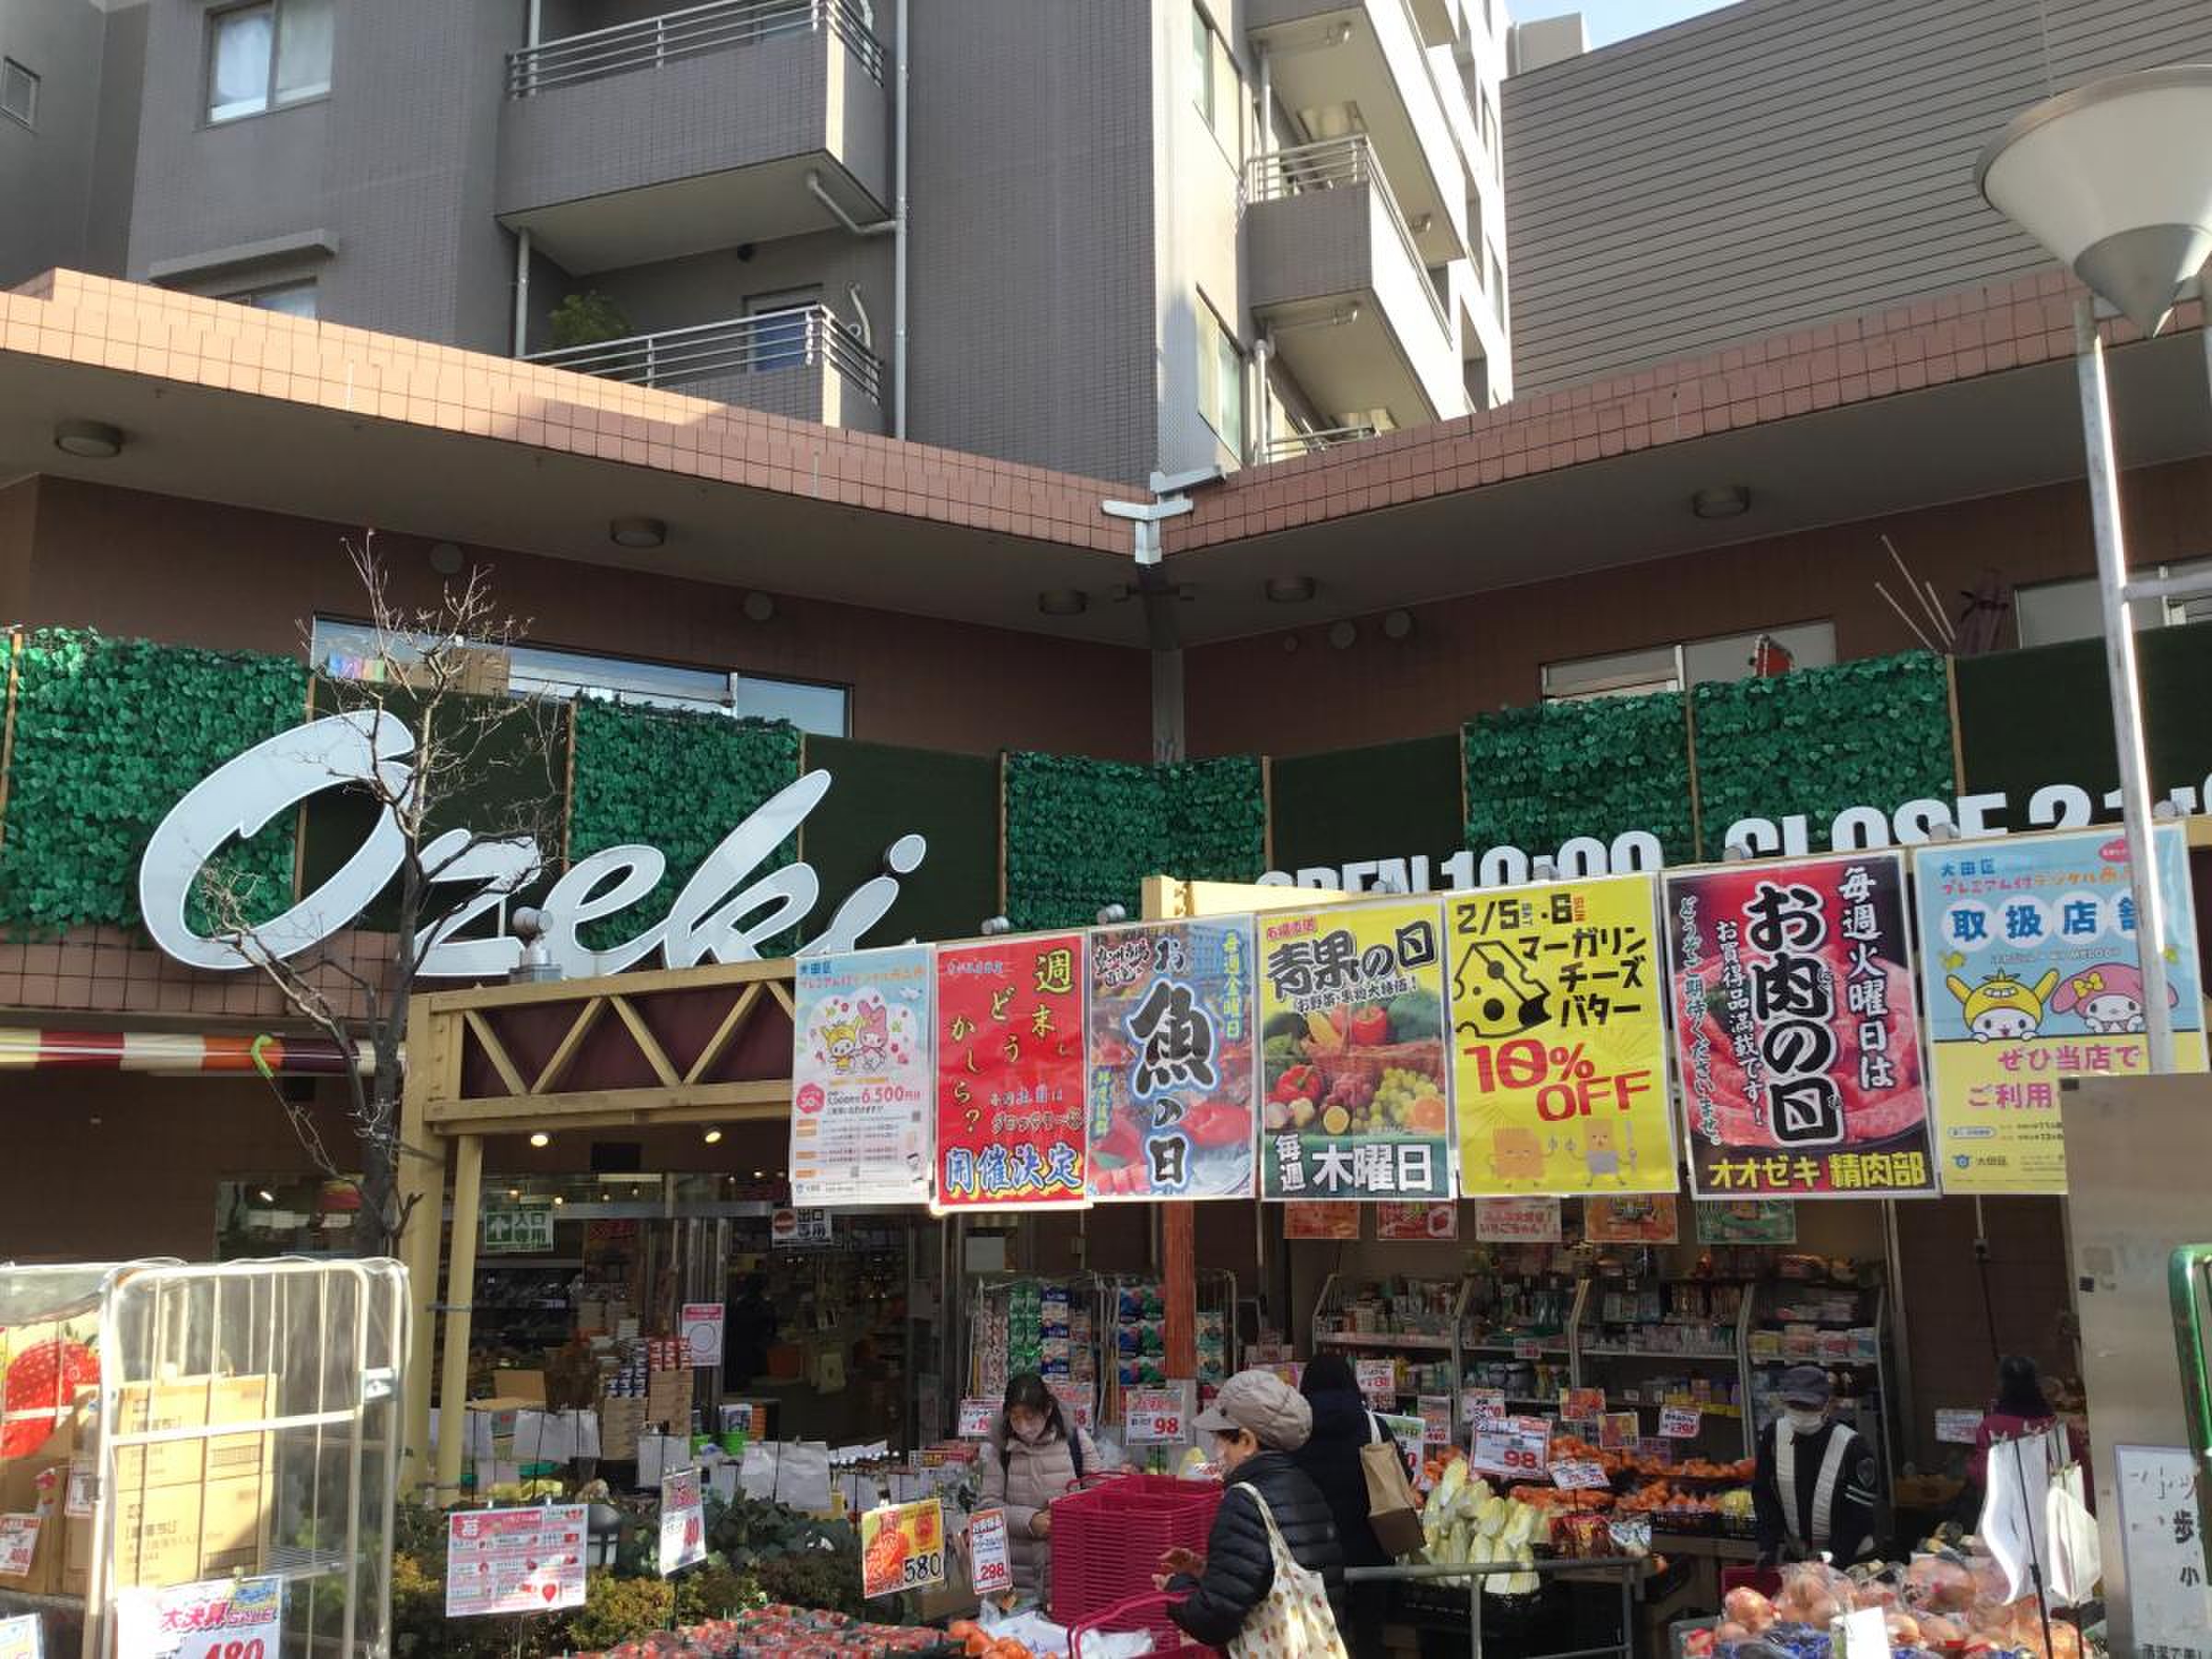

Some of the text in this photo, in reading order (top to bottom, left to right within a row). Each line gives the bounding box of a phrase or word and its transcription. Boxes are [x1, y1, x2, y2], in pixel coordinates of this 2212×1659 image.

[138, 708, 927, 978] Ozeki
[1254, 854, 1430, 894] EN
[1941, 858, 1994, 877] 大田区
[1267, 920, 1438, 1003] 青果の日
[1519, 926, 1646, 962] マーガリン
[1559, 956, 1646, 993] チーズ
[1839, 866, 1895, 1090] 毎週火曜日は
[1560, 994, 1641, 1028] バター
[1743, 881, 1844, 1147] お肉の日
[1464, 1039, 1594, 1094] 10%
[1997, 1043, 2142, 1073] ぜひ当店で
[1536, 1069, 1652, 1122] OFF
[1967, 1082, 2061, 1109] ご利用
[945, 1142, 1083, 1195] 開催決定
[1276, 1134, 1434, 1192] 毎週 木曜日
[1709, 1152, 1925, 1189] オオゼキ 精肉部
[1154, 1417, 1179, 1435] 98
[1504, 1450, 1537, 1470] 98
[903, 1552, 942, 1583] 580
